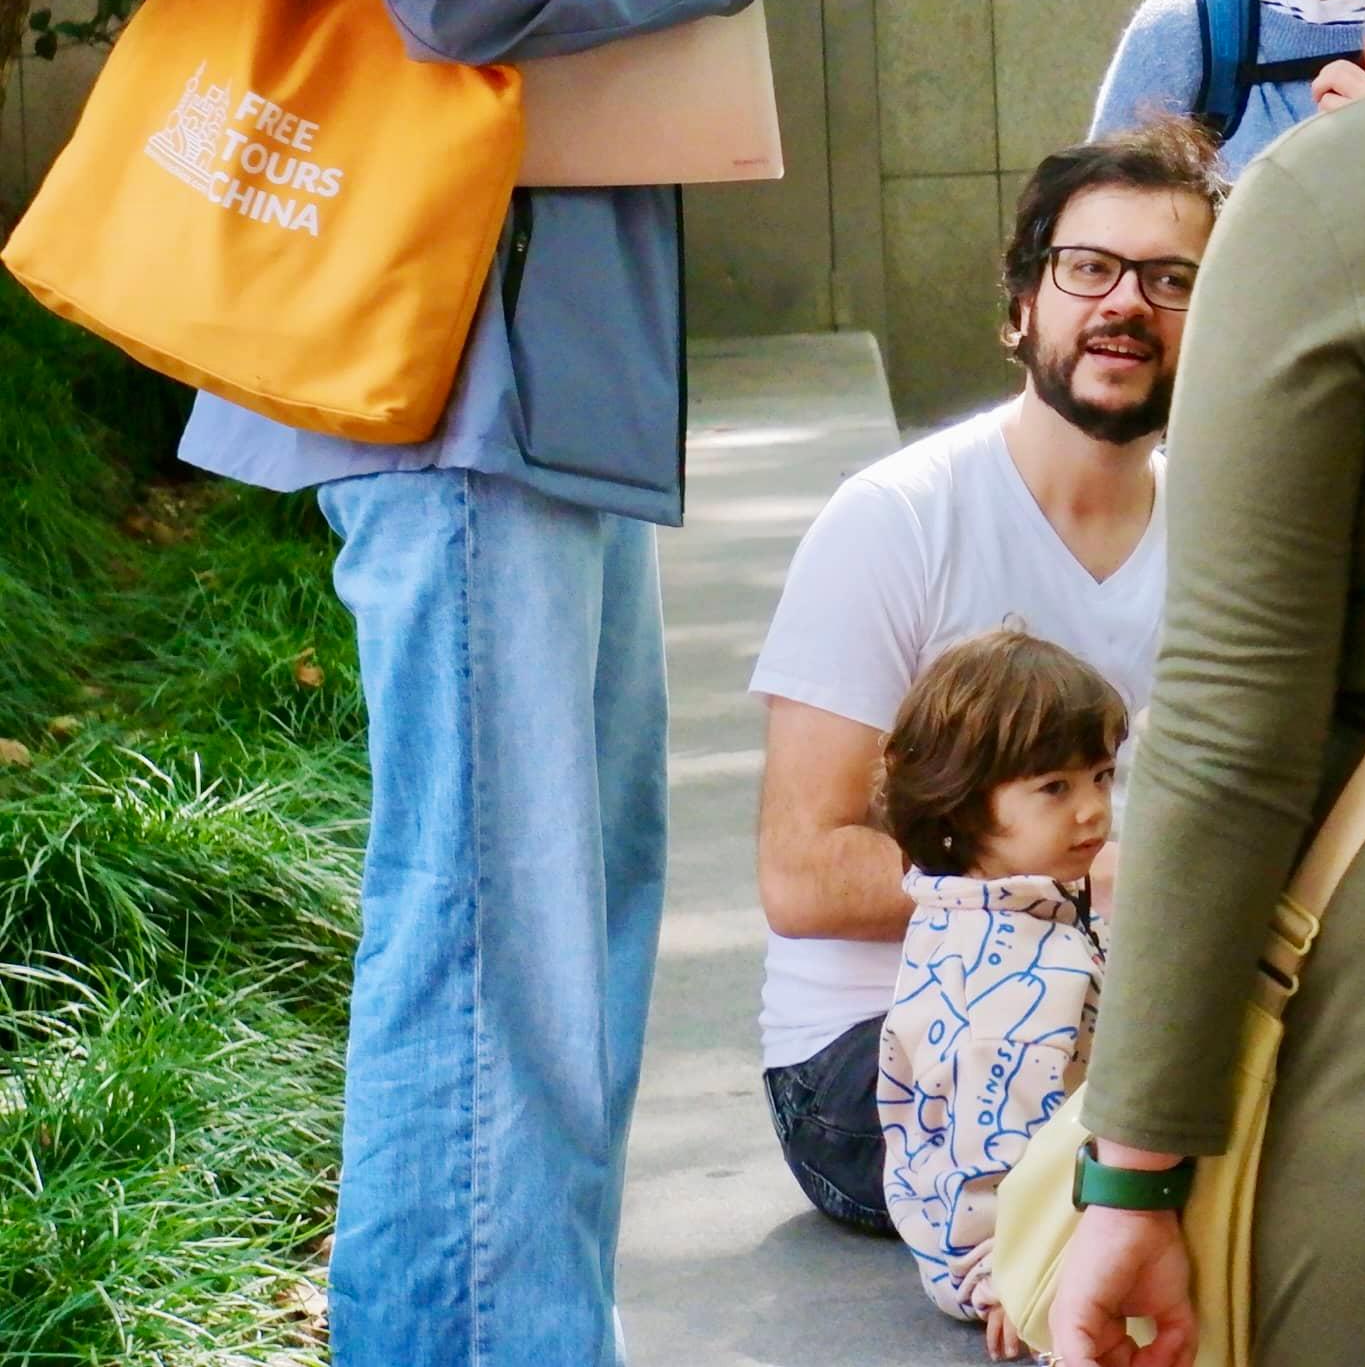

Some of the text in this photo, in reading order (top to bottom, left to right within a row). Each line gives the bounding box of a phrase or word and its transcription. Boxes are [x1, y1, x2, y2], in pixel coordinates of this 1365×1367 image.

[234, 90, 320, 153] FREE
[221, 128, 345, 198] TOURS
[207, 170, 319, 237] CHINA
